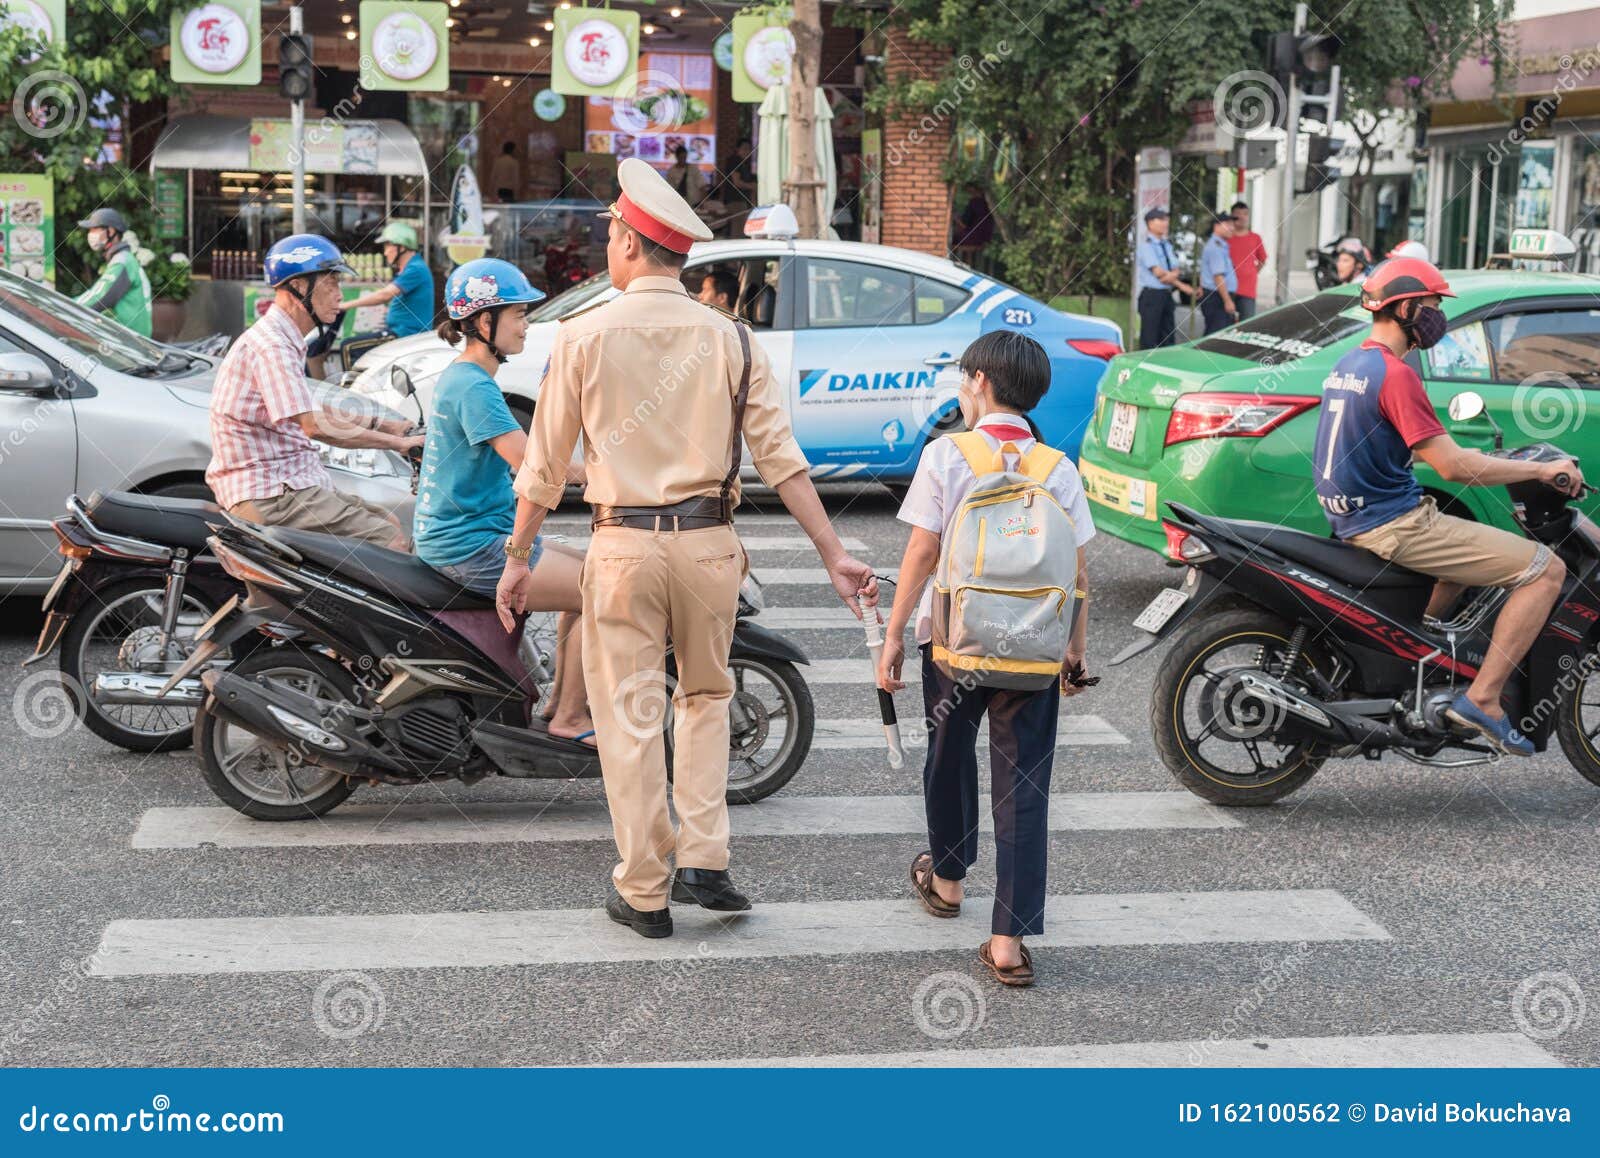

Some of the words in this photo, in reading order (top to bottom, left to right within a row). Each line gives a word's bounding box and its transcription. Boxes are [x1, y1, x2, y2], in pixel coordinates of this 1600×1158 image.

[1005, 308, 1032, 325] 271
[828, 372, 936, 391] DAIKIN
[1322, 399, 1345, 480] 7
